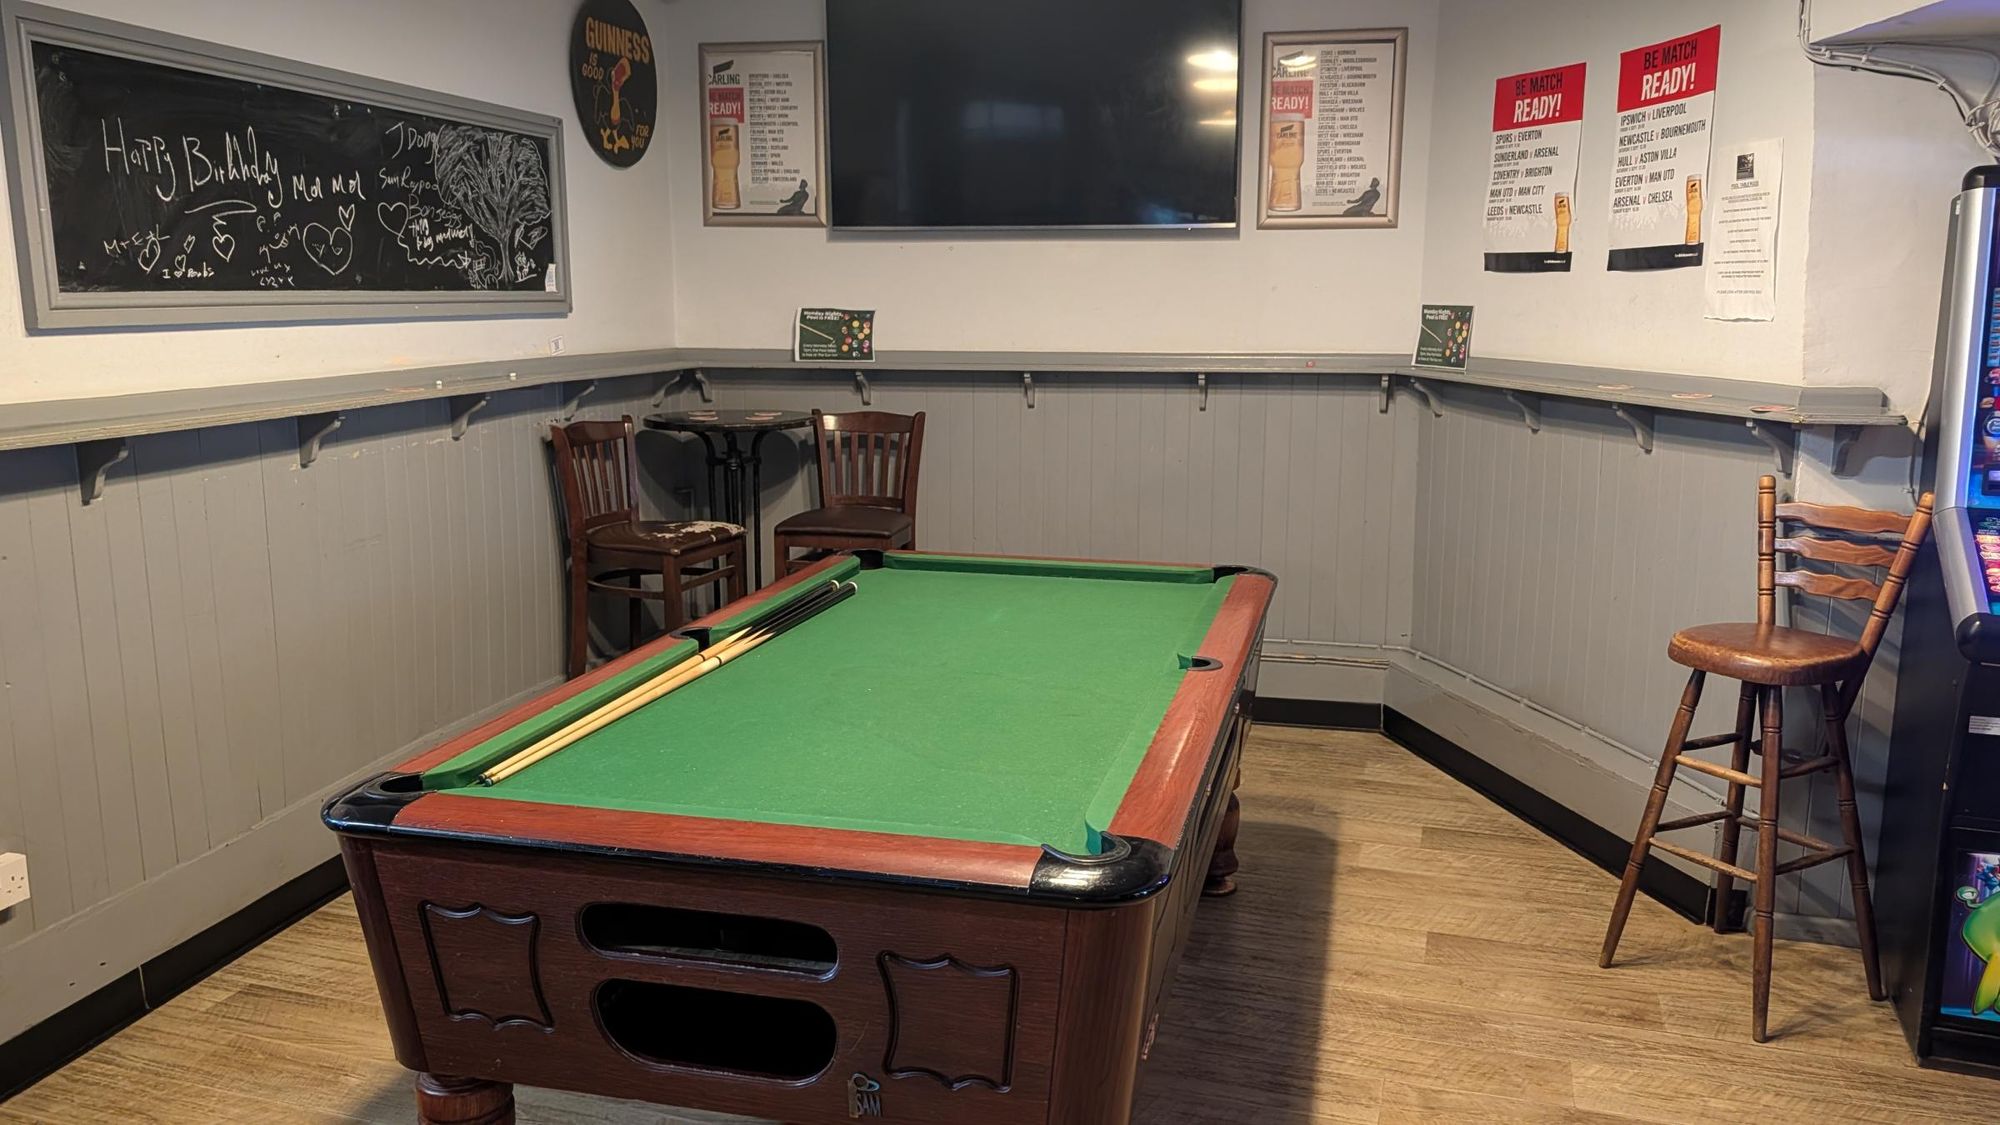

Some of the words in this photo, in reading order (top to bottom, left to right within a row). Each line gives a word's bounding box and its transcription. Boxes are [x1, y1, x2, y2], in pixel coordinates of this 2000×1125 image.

[586, 16, 650, 64] GUINNESS
[589, 52, 598, 66] IS
[1643, 50, 1659, 70] BE
[1661, 38, 1698, 65] MATCH
[582, 63, 604, 81] GOOD
[1516, 77, 1526, 96] BE
[1530, 72, 1563, 94] MATCH
[1640, 62, 1696, 101] READY!
[1272, 96, 1309, 110] READY!
[1513, 93, 1562, 123] READY!
[1620, 112, 1646, 126] IPSWICH
[1652, 103, 1687, 120] LIVERPOOL
[635, 124, 649, 138] FOR
[1496, 133, 1512, 144] SPURS
[1518, 130, 1542, 142] EVERTON
[1619, 131, 1654, 147] NEWCASTLE
[1661, 120, 1706, 139] BOURNEMOUTH
[631, 136, 645, 150] YOU
[101, 117, 176, 202] Happy
[1494, 150, 1528, 163] SUNDERLAND
[1534, 146, 1559, 158] ARSENAL
[1618, 155, 1632, 167] HULL
[1639, 150, 1658, 163] ASTON
[1660, 147, 1677, 160] VILLA
[1493, 169, 1519, 180] COVENTRY
[1525, 166, 1553, 178] BRIGHTON
[1615, 174, 1643, 187] EVERTON
[1649, 171, 1661, 182] MAN
[1663, 169, 1675, 180] UTD
[1490, 188, 1501, 198] MAN
[1503, 187, 1513, 197] UTD
[1518, 186, 1530, 196] MAN
[1532, 185, 1545, 195] CITY
[1613, 196, 1640, 208] ARSENAL
[1648, 191, 1673, 204] CHELSEA
[1488, 205, 1504, 216] LEEDS
[1509, 204, 1543, 215] NEWCASTLE
